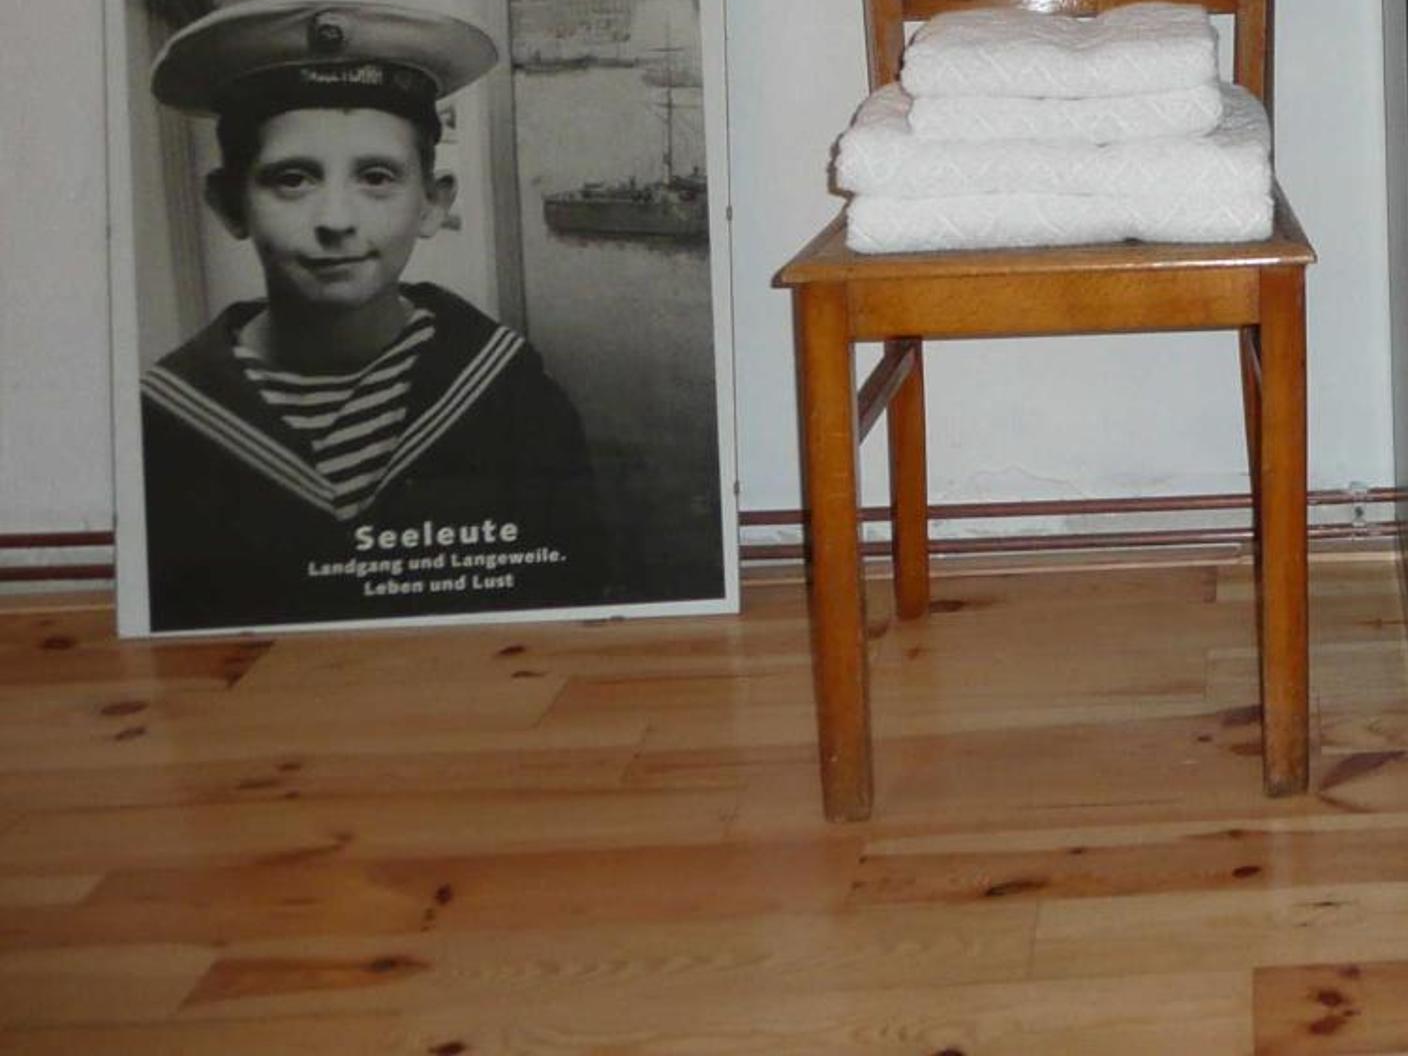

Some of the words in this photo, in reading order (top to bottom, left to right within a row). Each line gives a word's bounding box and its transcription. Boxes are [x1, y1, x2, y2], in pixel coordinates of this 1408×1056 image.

[355, 519, 519, 551] Seeleute
[309, 558, 403, 578] Landgang
[409, 553, 446, 570] und
[451, 547, 567, 570] Langeweile.
[364, 578, 425, 596] Leben
[430, 574, 467, 591] und
[473, 572, 516, 589] Lust
